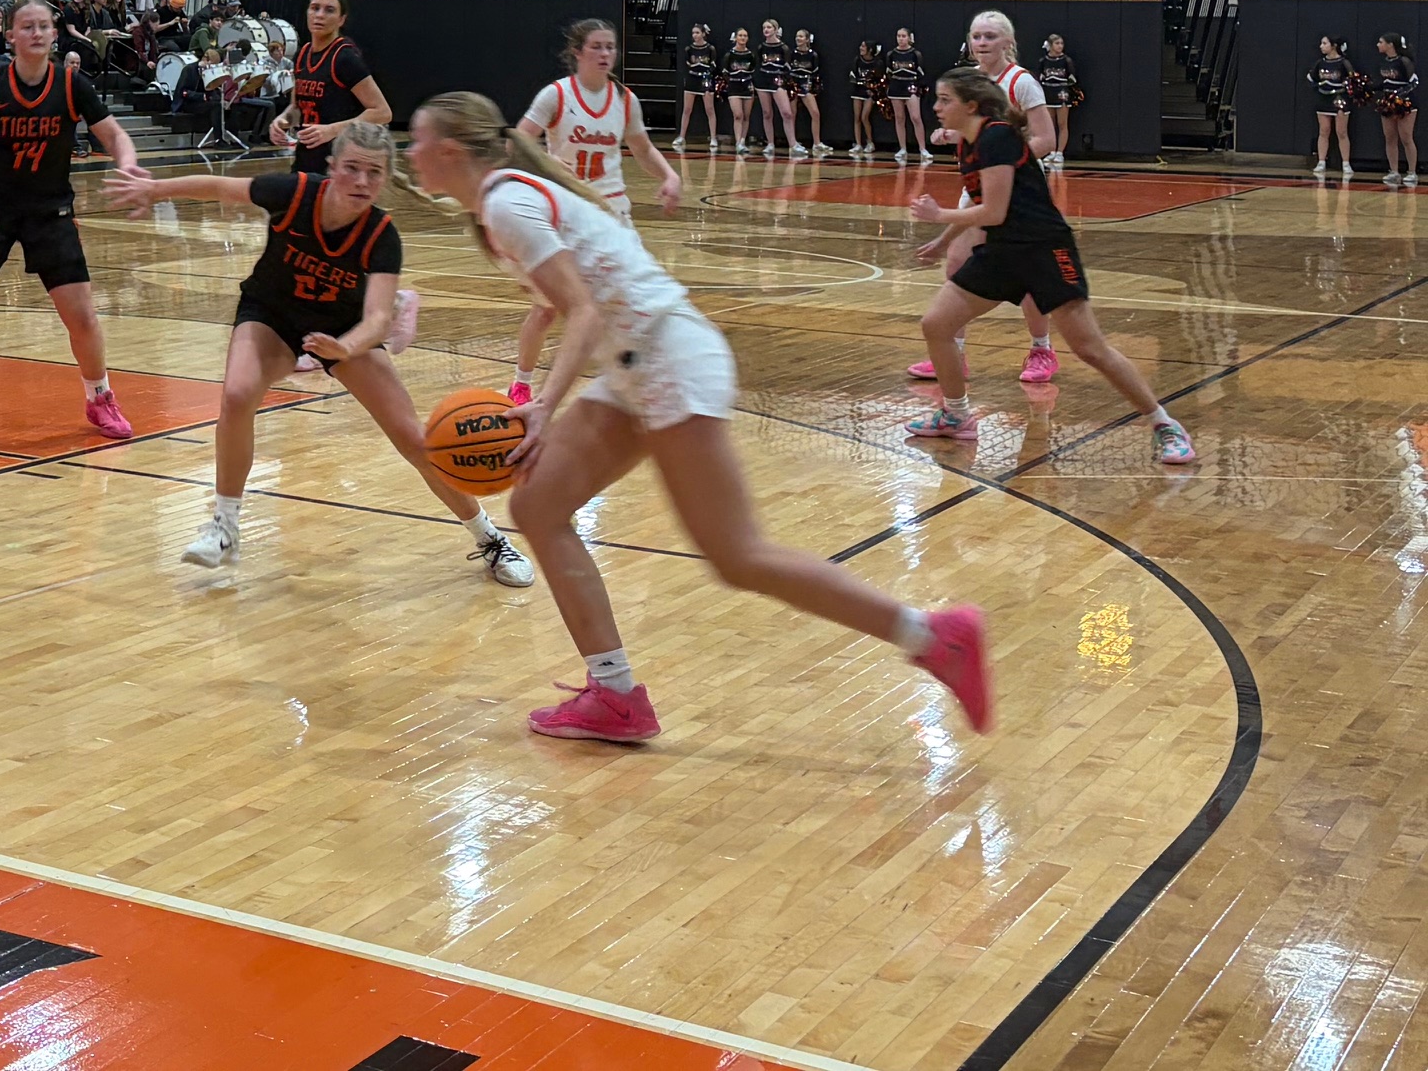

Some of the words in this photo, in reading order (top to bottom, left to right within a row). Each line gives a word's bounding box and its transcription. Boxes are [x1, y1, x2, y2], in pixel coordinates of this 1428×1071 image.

[0, 115, 62, 138] TIGERS
[283, 243, 358, 289] TIGERS
[455, 414, 509, 437] NCAA
